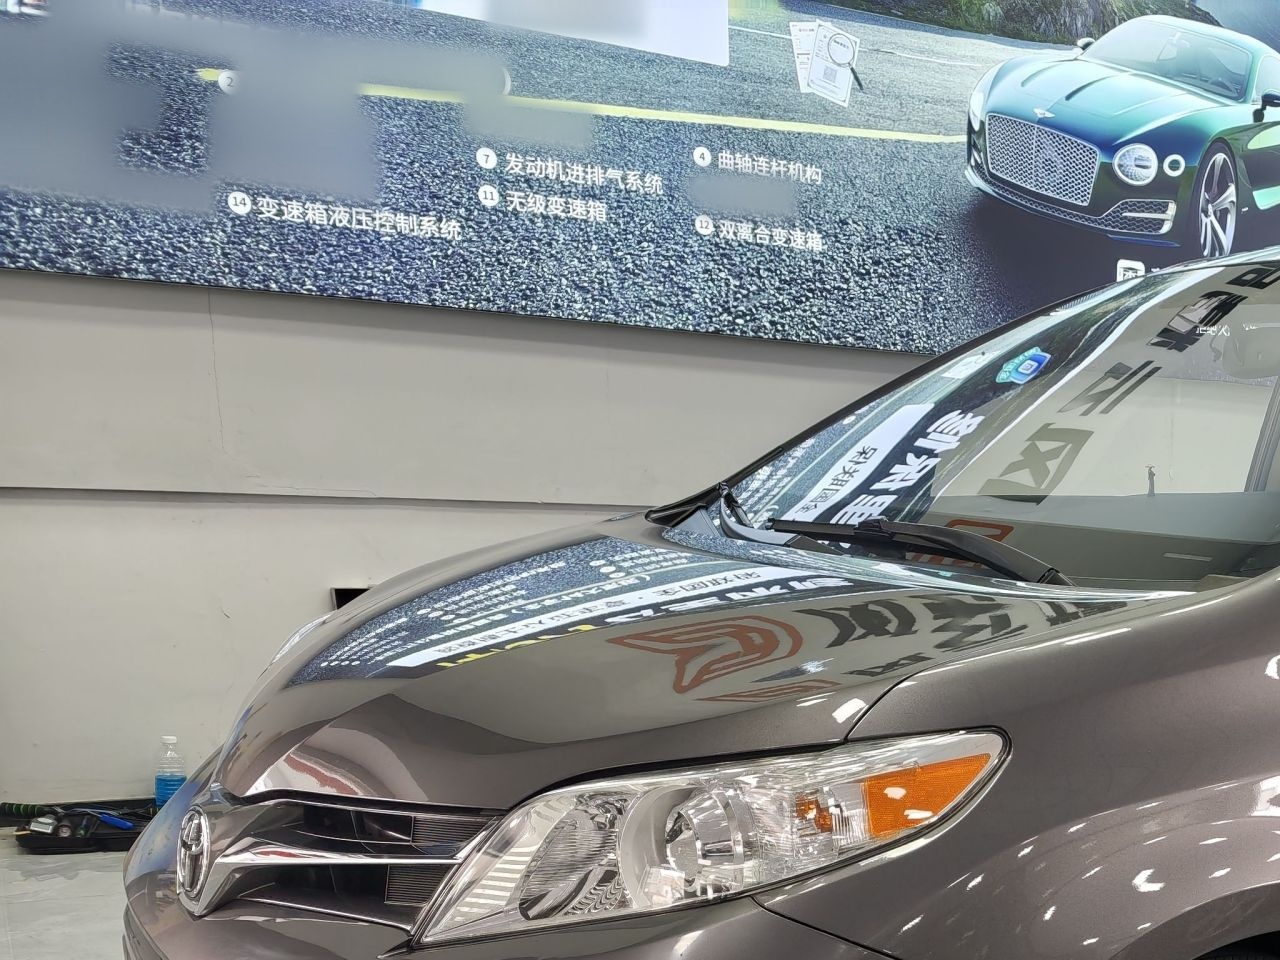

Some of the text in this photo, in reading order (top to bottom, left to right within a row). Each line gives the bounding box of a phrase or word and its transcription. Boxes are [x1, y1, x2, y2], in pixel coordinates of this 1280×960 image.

[505, 152, 664, 195] 发动机进排气系统
[718, 149, 822, 185] 曲轴连杆机构
[255, 196, 463, 241] 变速箱液压控制系统
[505, 189, 608, 223] 无级变速箱
[718, 219, 824, 252] 双离合变速箱
